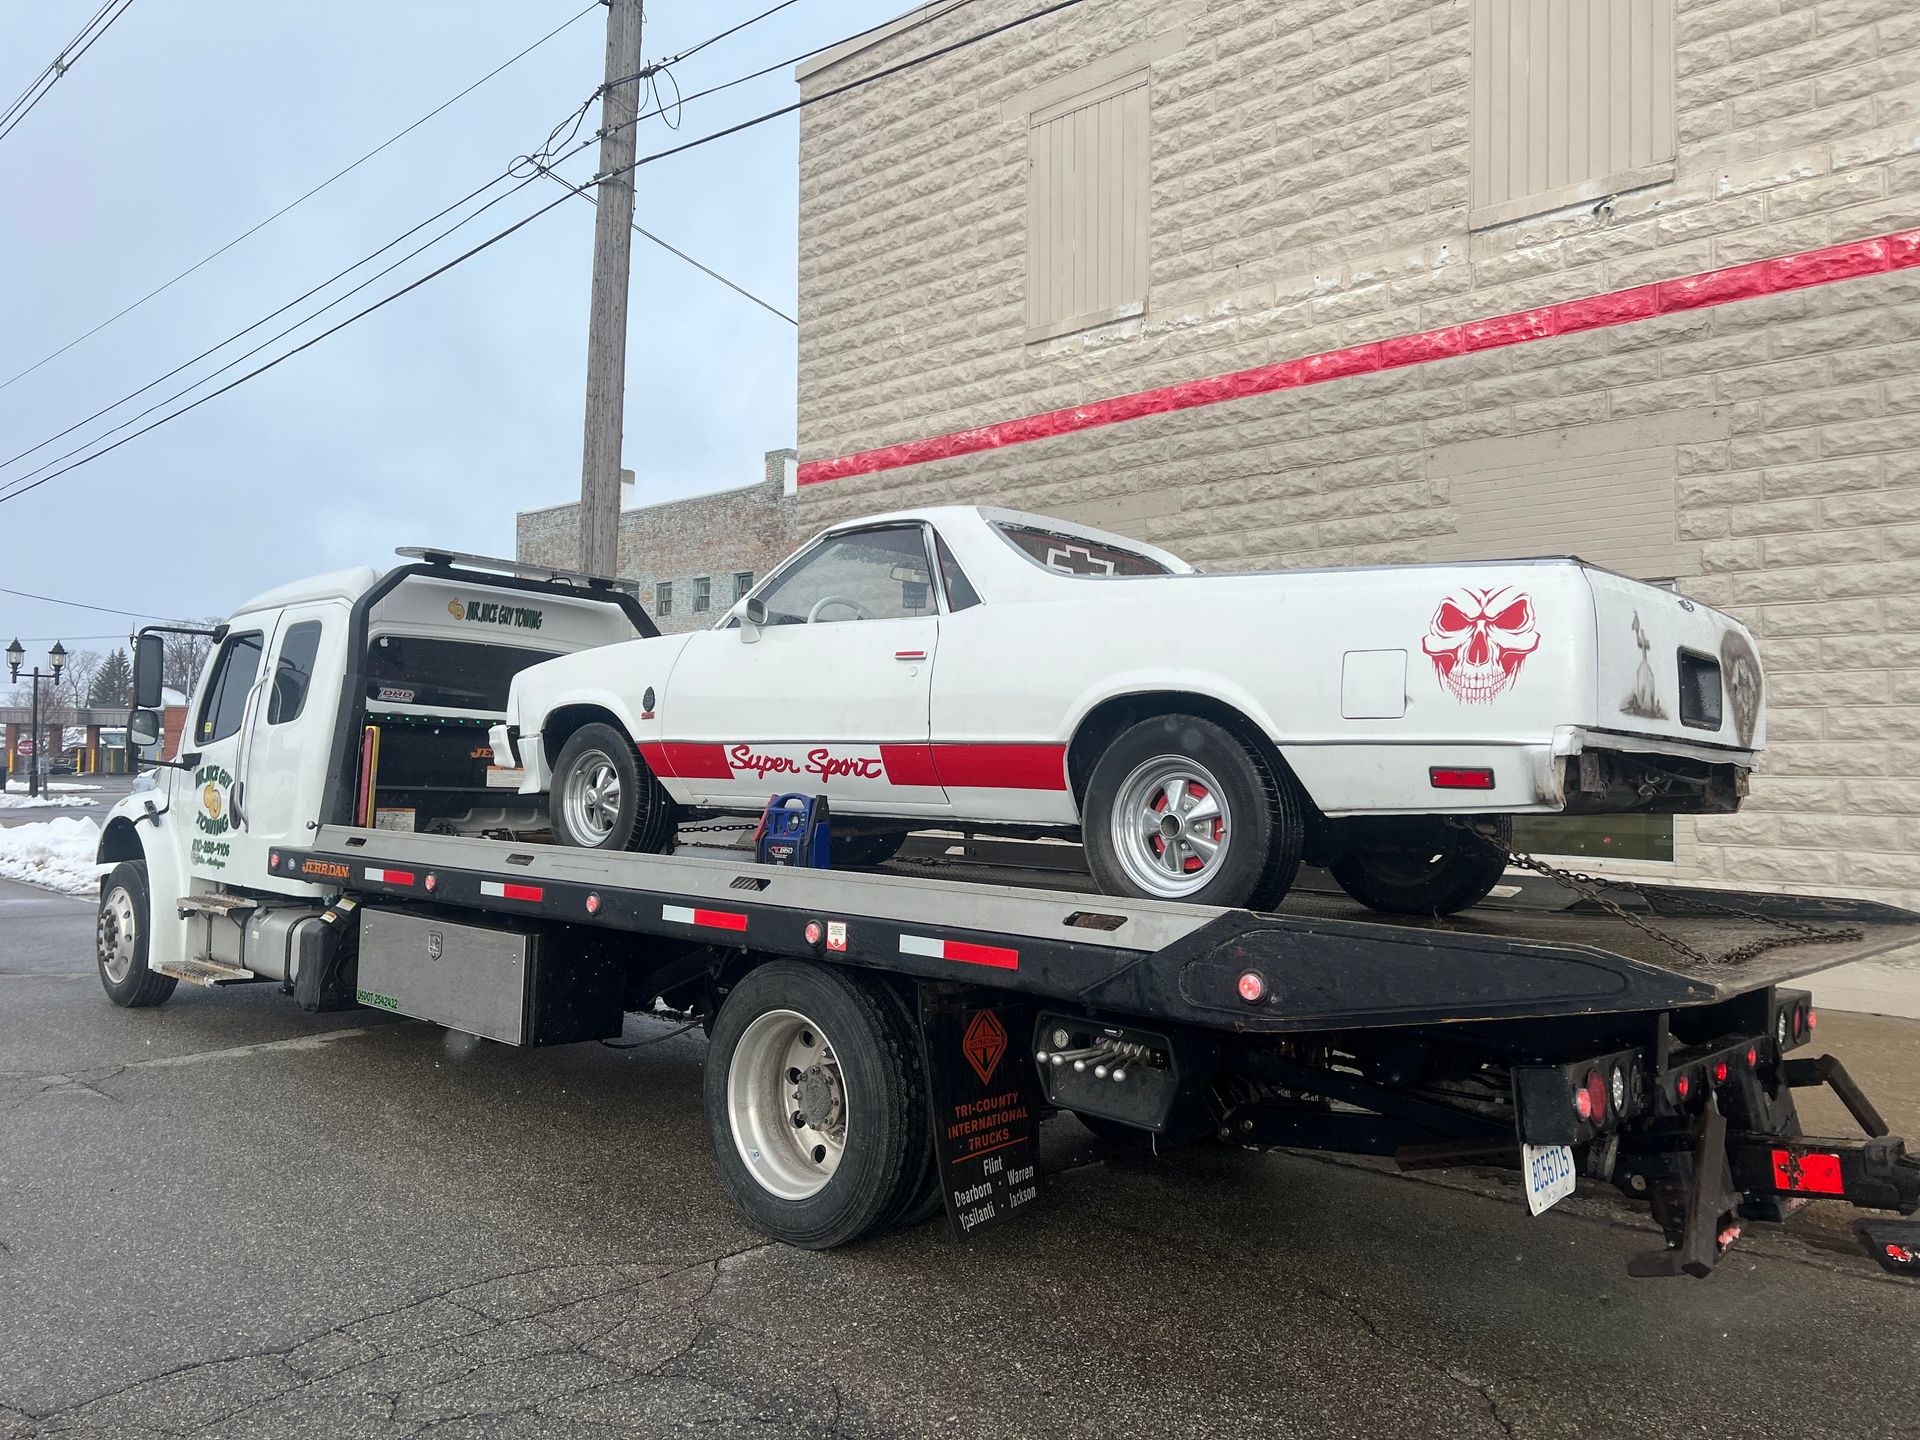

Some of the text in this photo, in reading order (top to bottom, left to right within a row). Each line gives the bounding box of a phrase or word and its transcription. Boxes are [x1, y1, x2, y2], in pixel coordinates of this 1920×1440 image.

[498, 605, 514, 625] GUY
[514, 607, 543, 630] TOWING
[730, 743, 882, 784] Super Sport
[218, 768, 233, 790] GUY
[195, 809, 229, 836] TOWING
[954, 1092, 1019, 1119] TRI-COUNTY
[947, 1106, 1028, 1140] INTERNATIONAL
[968, 1128, 1010, 1151] TRUCKS
[983, 1155, 1003, 1177] Flint
[1532, 1146, 1570, 1193] BC56715
[954, 1164, 1034, 1208] Dearborn Warren
[958, 1185, 1037, 1232] Ypsilanti Jackson
